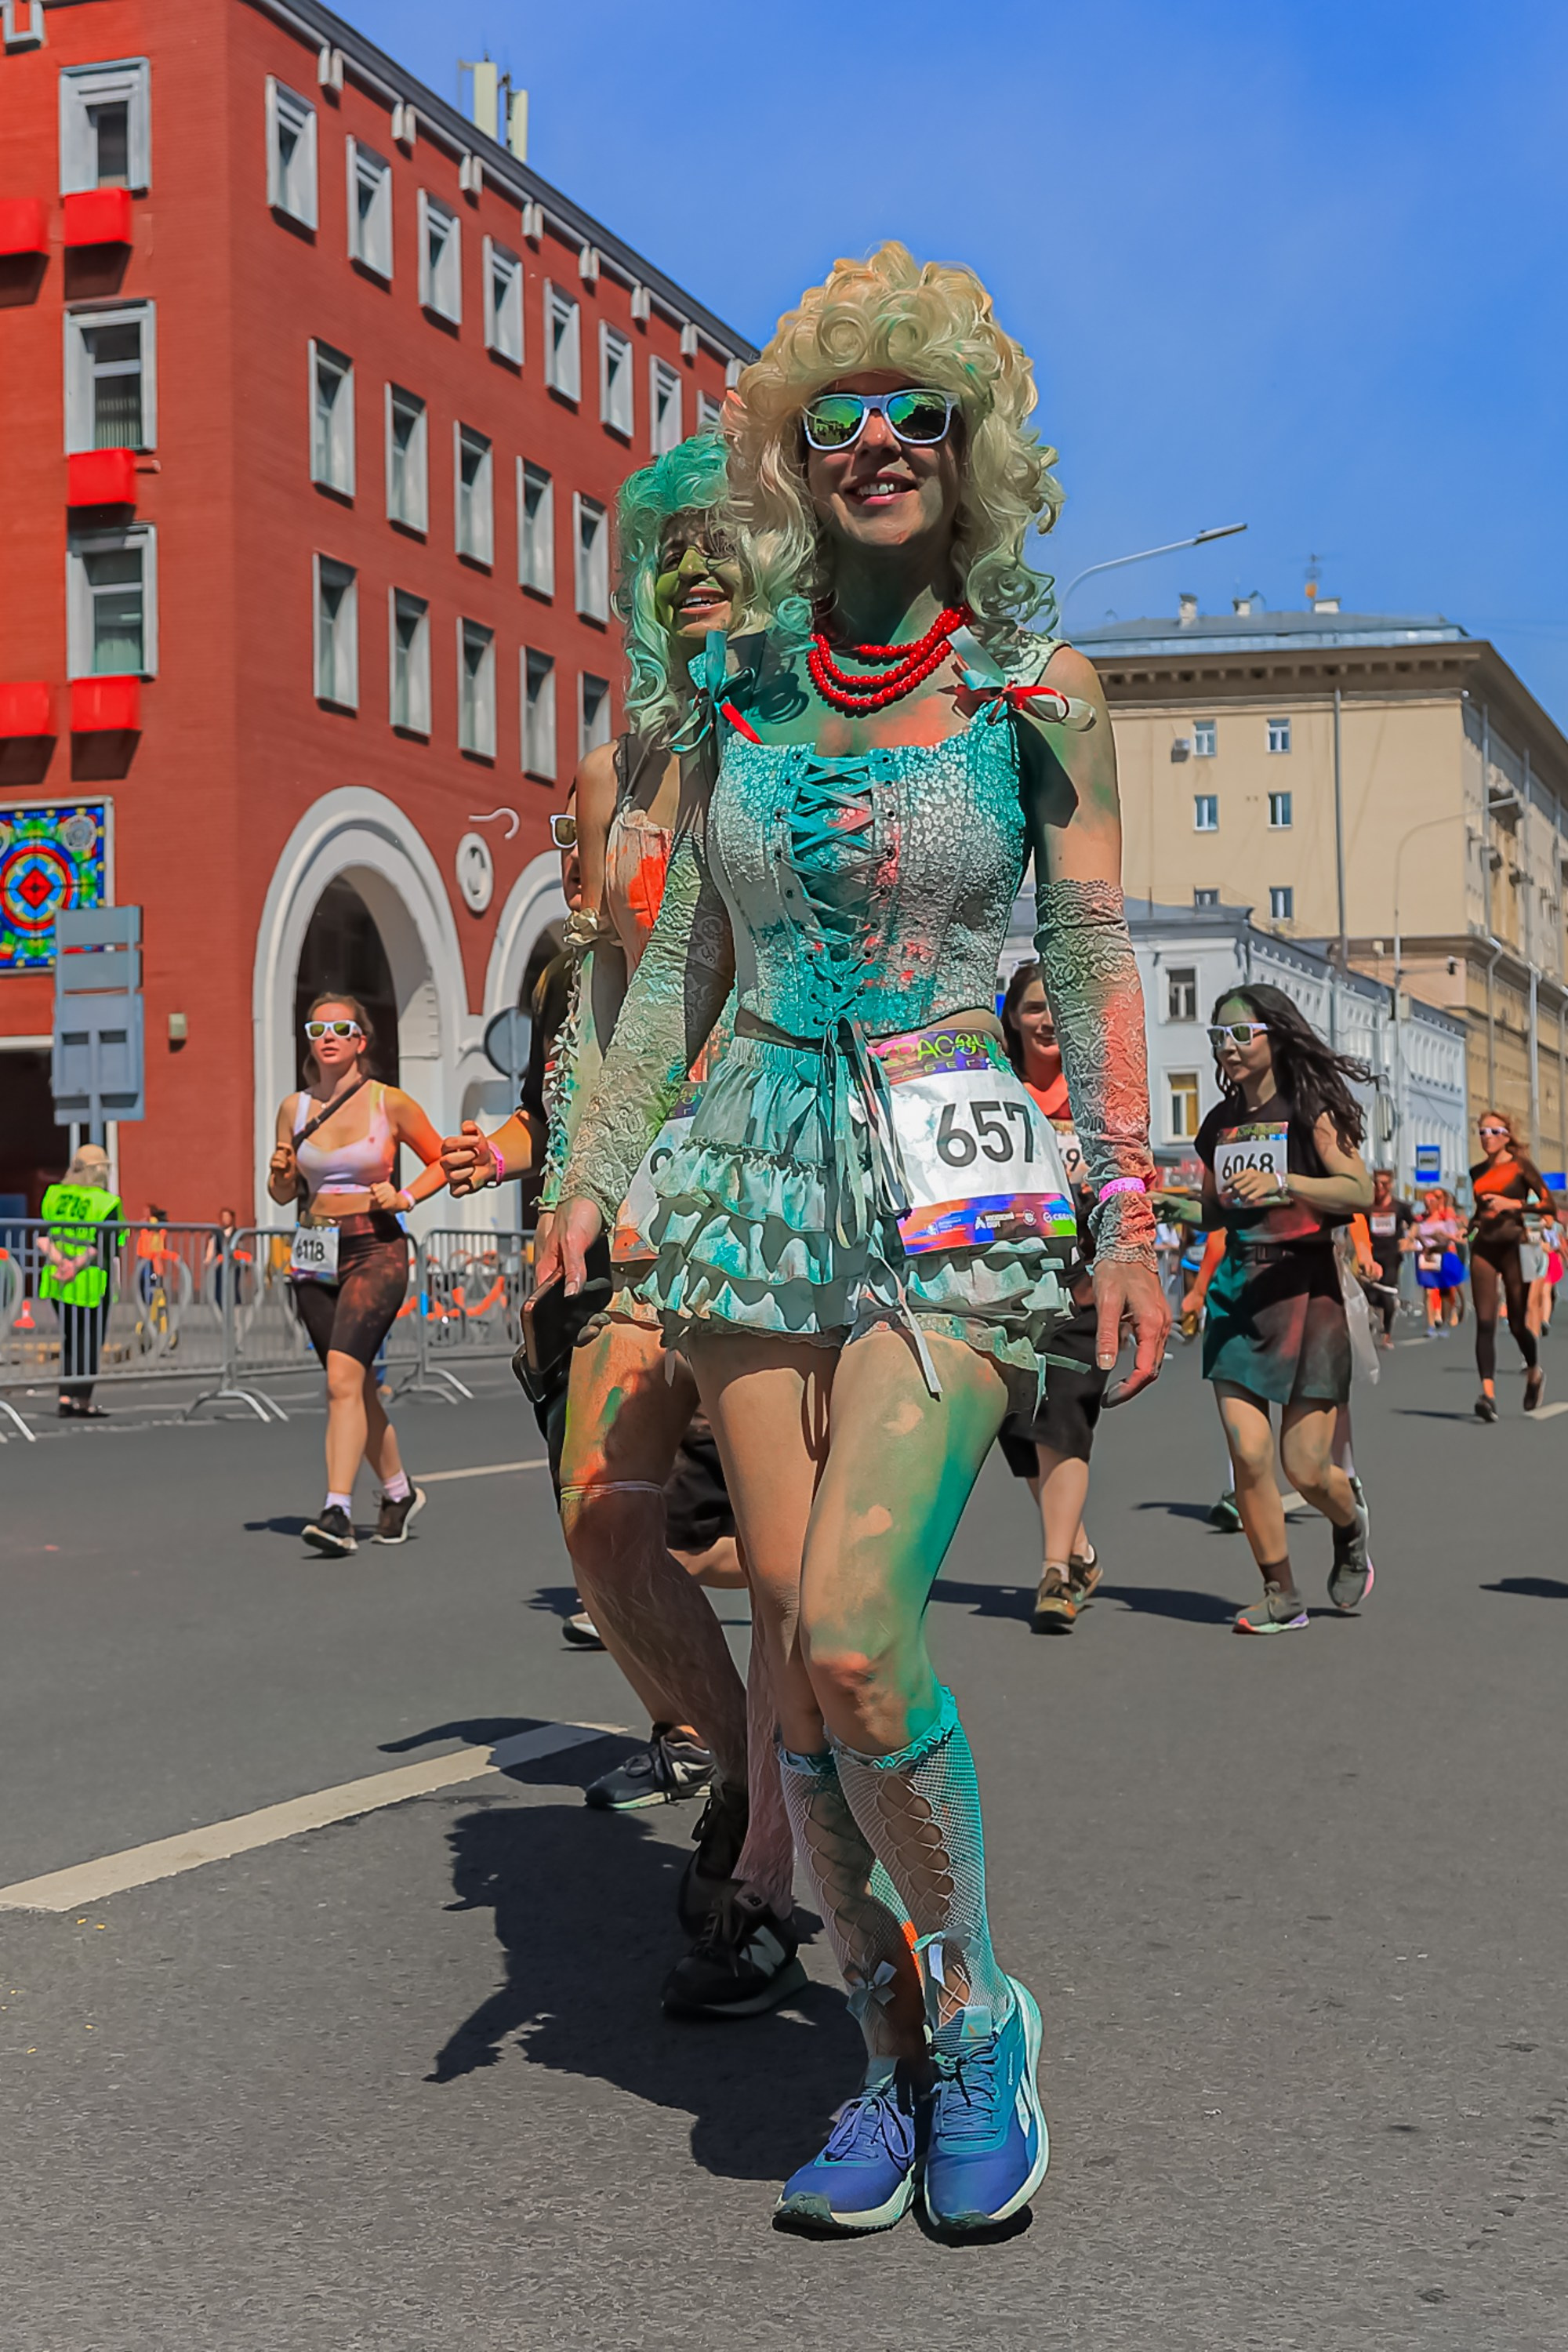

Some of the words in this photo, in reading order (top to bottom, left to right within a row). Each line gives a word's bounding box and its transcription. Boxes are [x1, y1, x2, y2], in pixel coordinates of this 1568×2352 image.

[902, 1059, 975, 1077] АБЕГ
[936, 1101, 1034, 1167] 657
[1222, 1152, 1274, 1181] 6068
